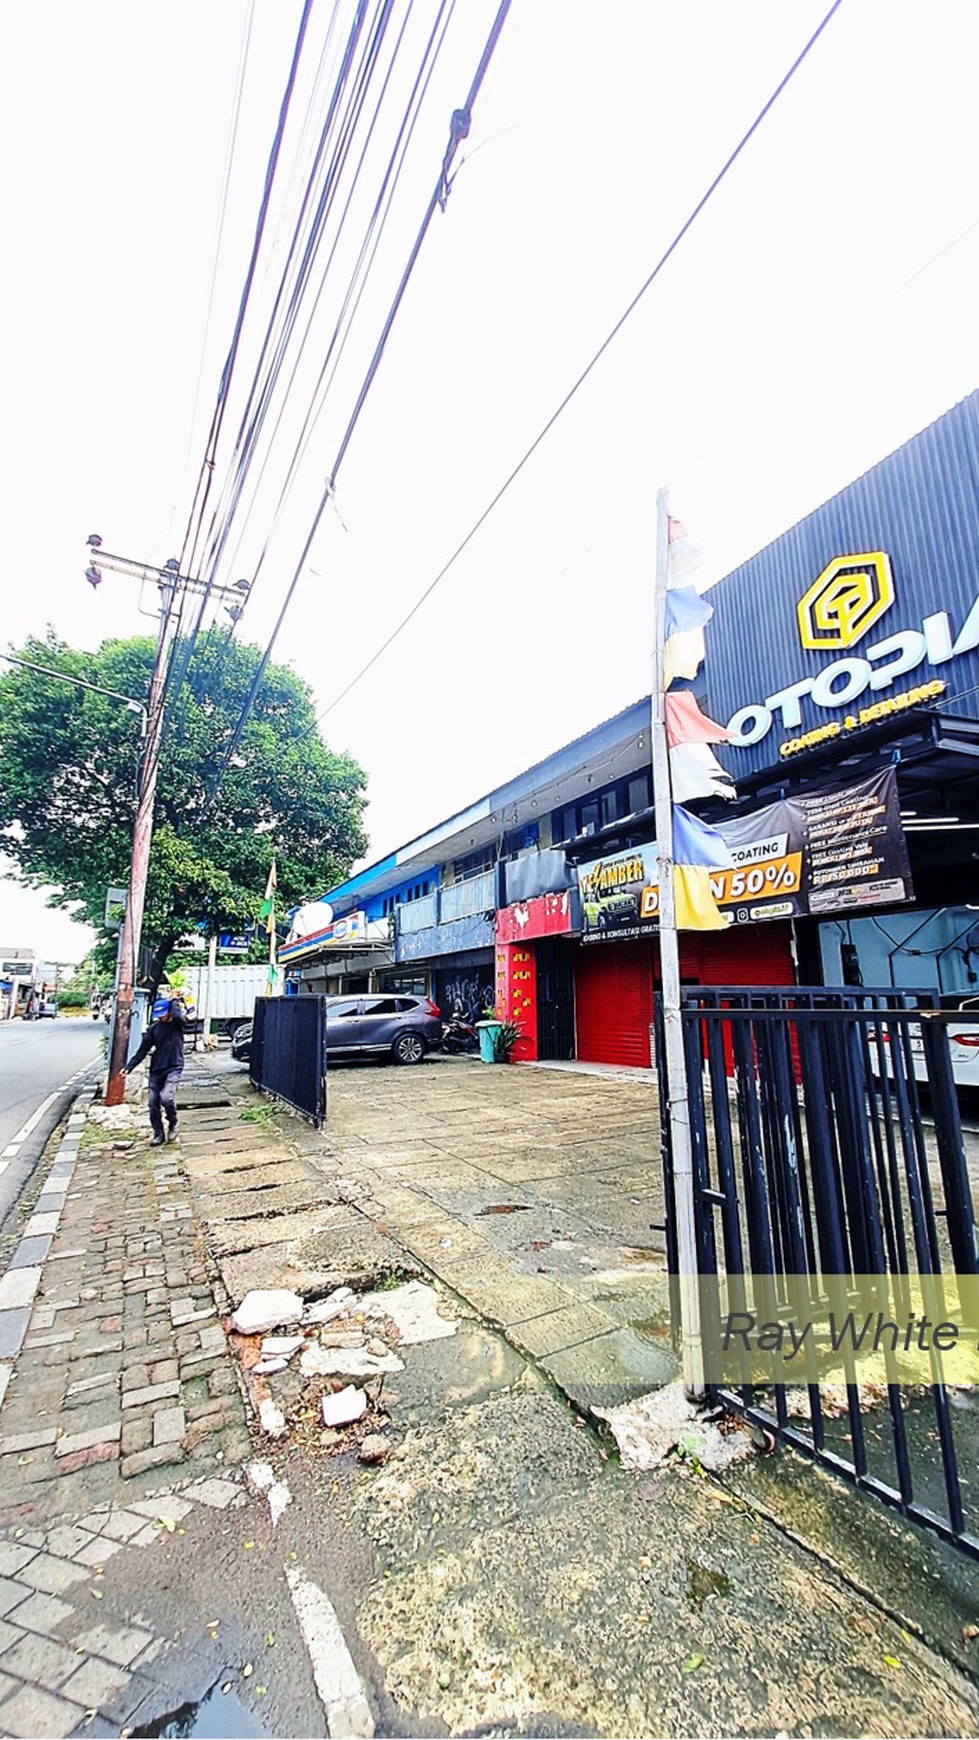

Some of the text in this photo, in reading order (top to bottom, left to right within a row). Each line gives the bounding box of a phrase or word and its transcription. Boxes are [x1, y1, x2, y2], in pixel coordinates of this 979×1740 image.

[779, 679, 946, 757] COATING & DETAILING
[730, 862, 795, 897] 50%
